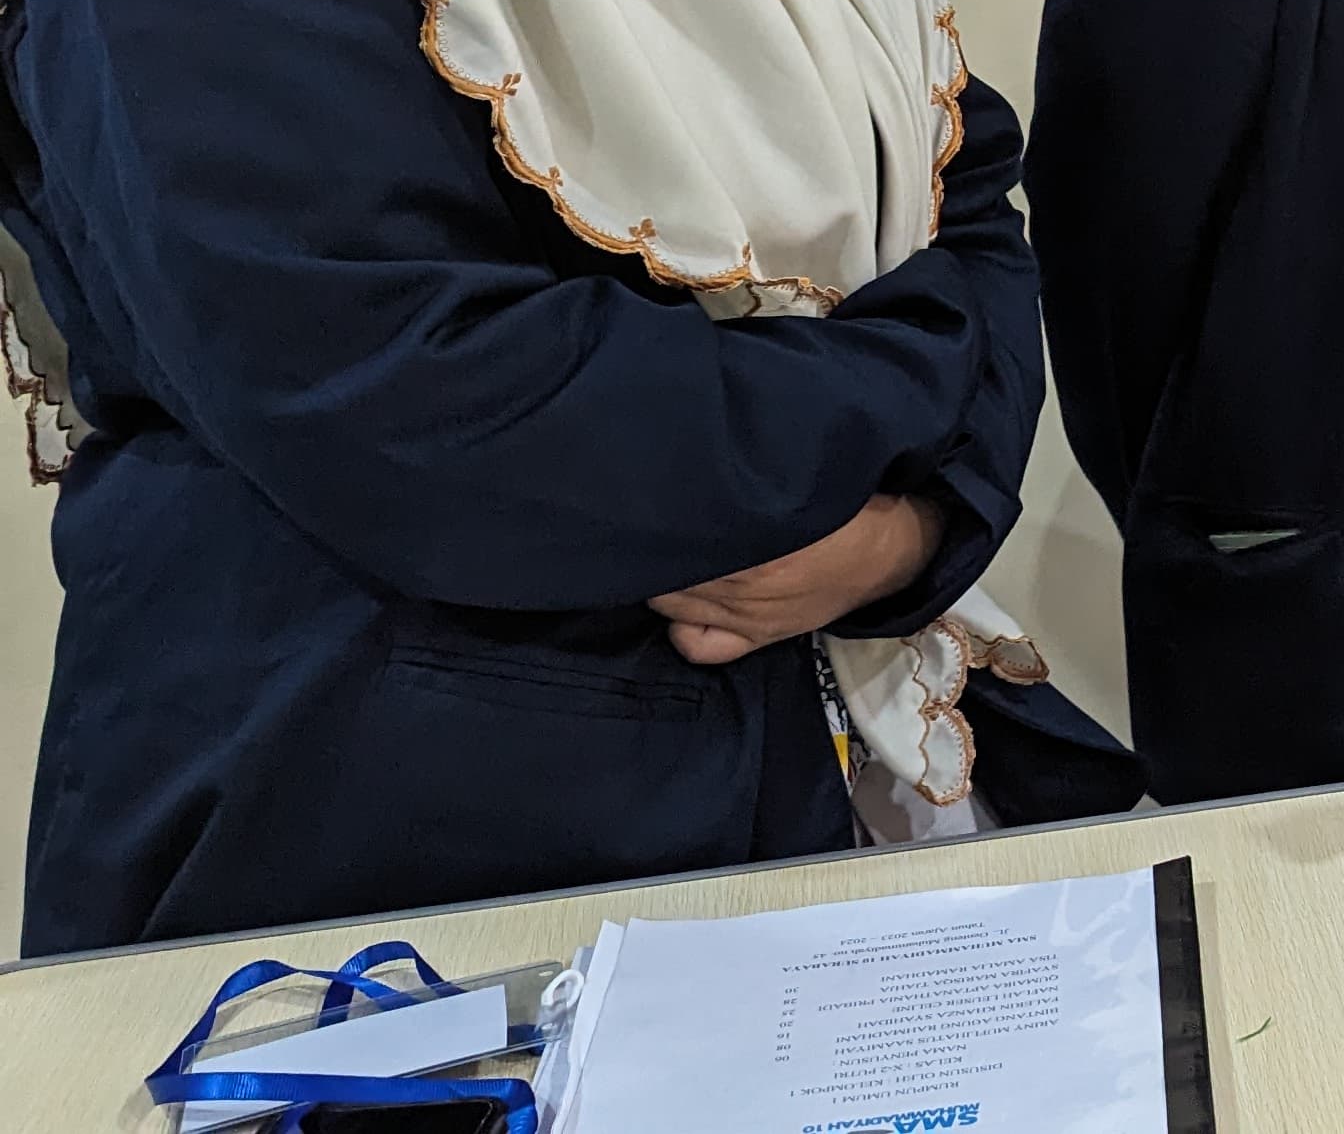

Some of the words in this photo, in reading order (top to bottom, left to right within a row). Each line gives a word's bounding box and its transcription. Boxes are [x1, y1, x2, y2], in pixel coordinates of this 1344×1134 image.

[911, 927, 948, 936] Ajaran
[951, 922, 984, 930] Tahun
[841, 938, 866, 946] 2024
[881, 933, 908, 941] 2023
[943, 932, 988, 942] Genteng
[1008, 935, 1036, 943] SMA
[880, 940, 1003, 961] MUHAMMADIYAH
[782, 959, 859, 972] SURABAYA
[972, 958, 1025, 970] AMALIA
[882, 967, 967, 982] RAMADHANI
[1001, 964, 1058, 977] SYAFIRA
[933, 973, 997, 985] MARISQA
[993, 974, 1058, 989] QUMAIRA
[784, 986, 800, 995] 30
[1003, 985, 1058, 999] NAFLAH
[783, 997, 798, 1006] 28
[819, 999, 874, 1011] PRIBADI
[892, 1002, 942, 1013] CELINE
[781, 1008, 796, 1017] 25
[937, 1006, 996, 1018] KHANZA
[995, 1007, 1058, 1022] BINTANG
[778, 1019, 794, 1029] 20
[858, 1014, 933, 1029] SYAHIDAH
[1014, 1019, 1059, 1031] ARINY
[776, 1032, 791, 1040] 16
[836, 1025, 936, 1043] RAHMADHANI
[835, 1039, 913, 1055] SAAMIYAH
[923, 1044, 966, 1055] NAMA
[840, 1050, 918, 1066] PENYUSUN
[915, 1056, 962, 1068] KELAS
[834, 1068, 876, 1079] PUTRI
[881, 1064, 903, 1073] X-2
[939, 1063, 1002, 1077] DISUSUN
[896, 1072, 935, 1083] OLEH
[801, 1079, 883, 1095] KELOMPOK
[895, 1081, 958, 1096] RUMPUN
[843, 1091, 890, 1103] UMUM
[828, 1102, 980, 1131] MUHAMMADIYAH
[802, 1123, 823, 1134] 10
[892, 1112, 979, 1134] SMA
